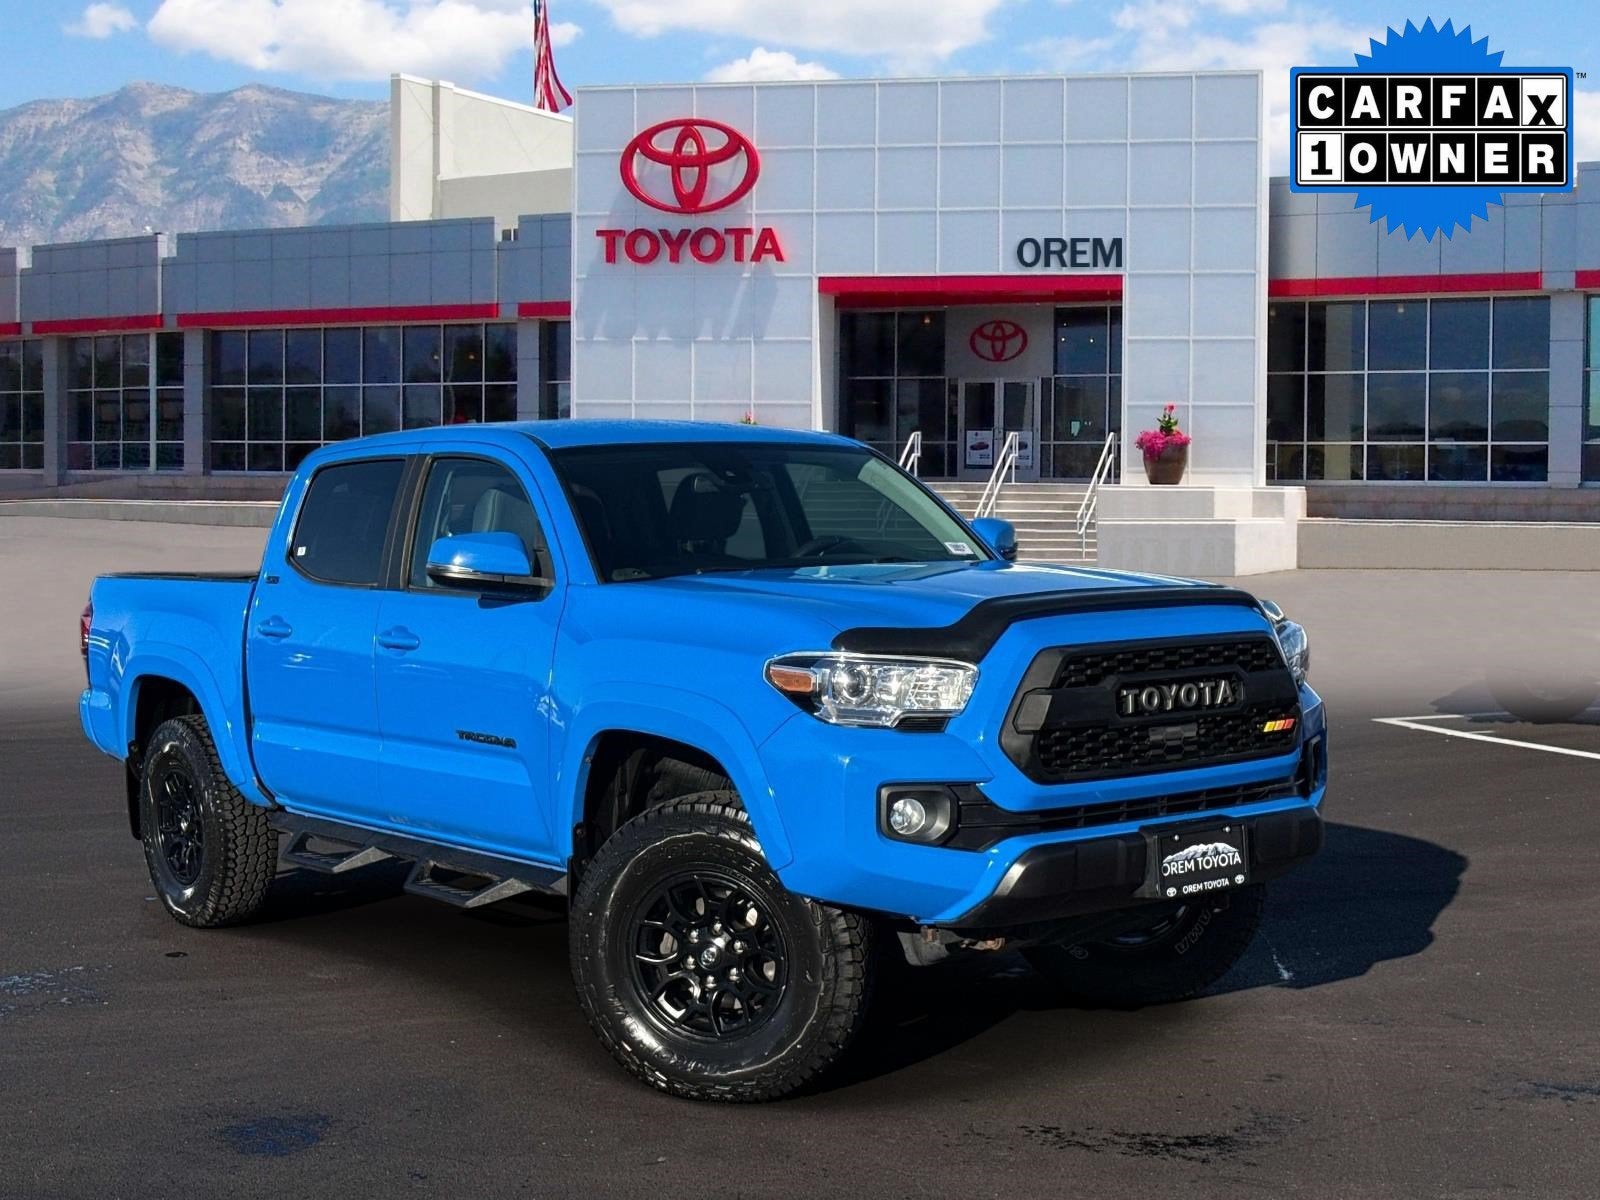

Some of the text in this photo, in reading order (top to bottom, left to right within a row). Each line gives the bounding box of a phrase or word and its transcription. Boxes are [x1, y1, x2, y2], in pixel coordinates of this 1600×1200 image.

[596, 227, 784, 264] TOYOTA
[1016, 237, 1123, 268] OREM
[1121, 680, 1234, 714] TOYOTA
[1161, 851, 1242, 877] OREM TOYOTA
[1182, 877, 1230, 895] OREM TOYOTA
